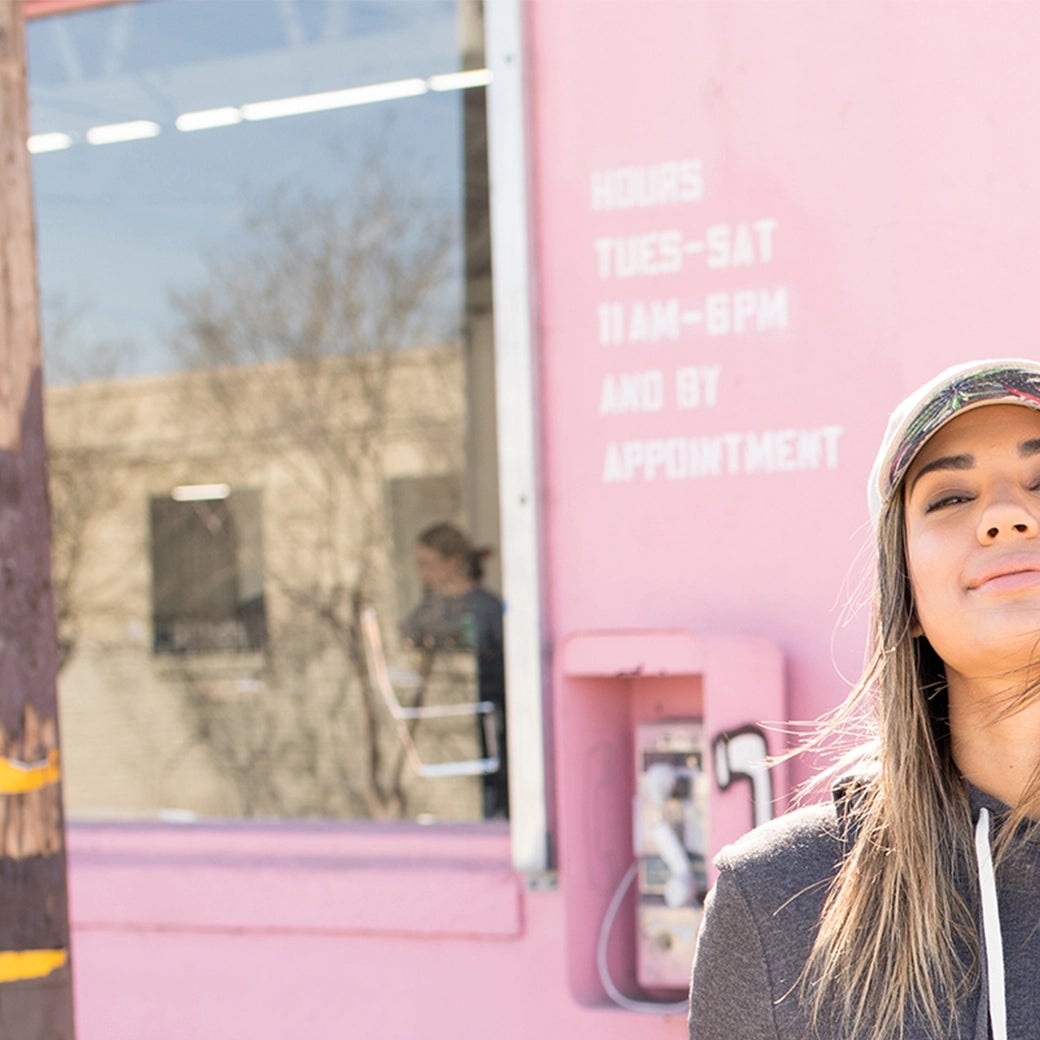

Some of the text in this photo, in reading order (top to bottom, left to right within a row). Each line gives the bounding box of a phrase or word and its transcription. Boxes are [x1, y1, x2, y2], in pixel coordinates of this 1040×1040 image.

[591, 158, 703, 211] HOURS
[594, 219, 777, 278] TUES-SAT
[597, 286, 788, 344] 11AM-6PM
[600, 365, 721, 414] AND BY
[603, 425, 843, 482] APPOINTMENT
